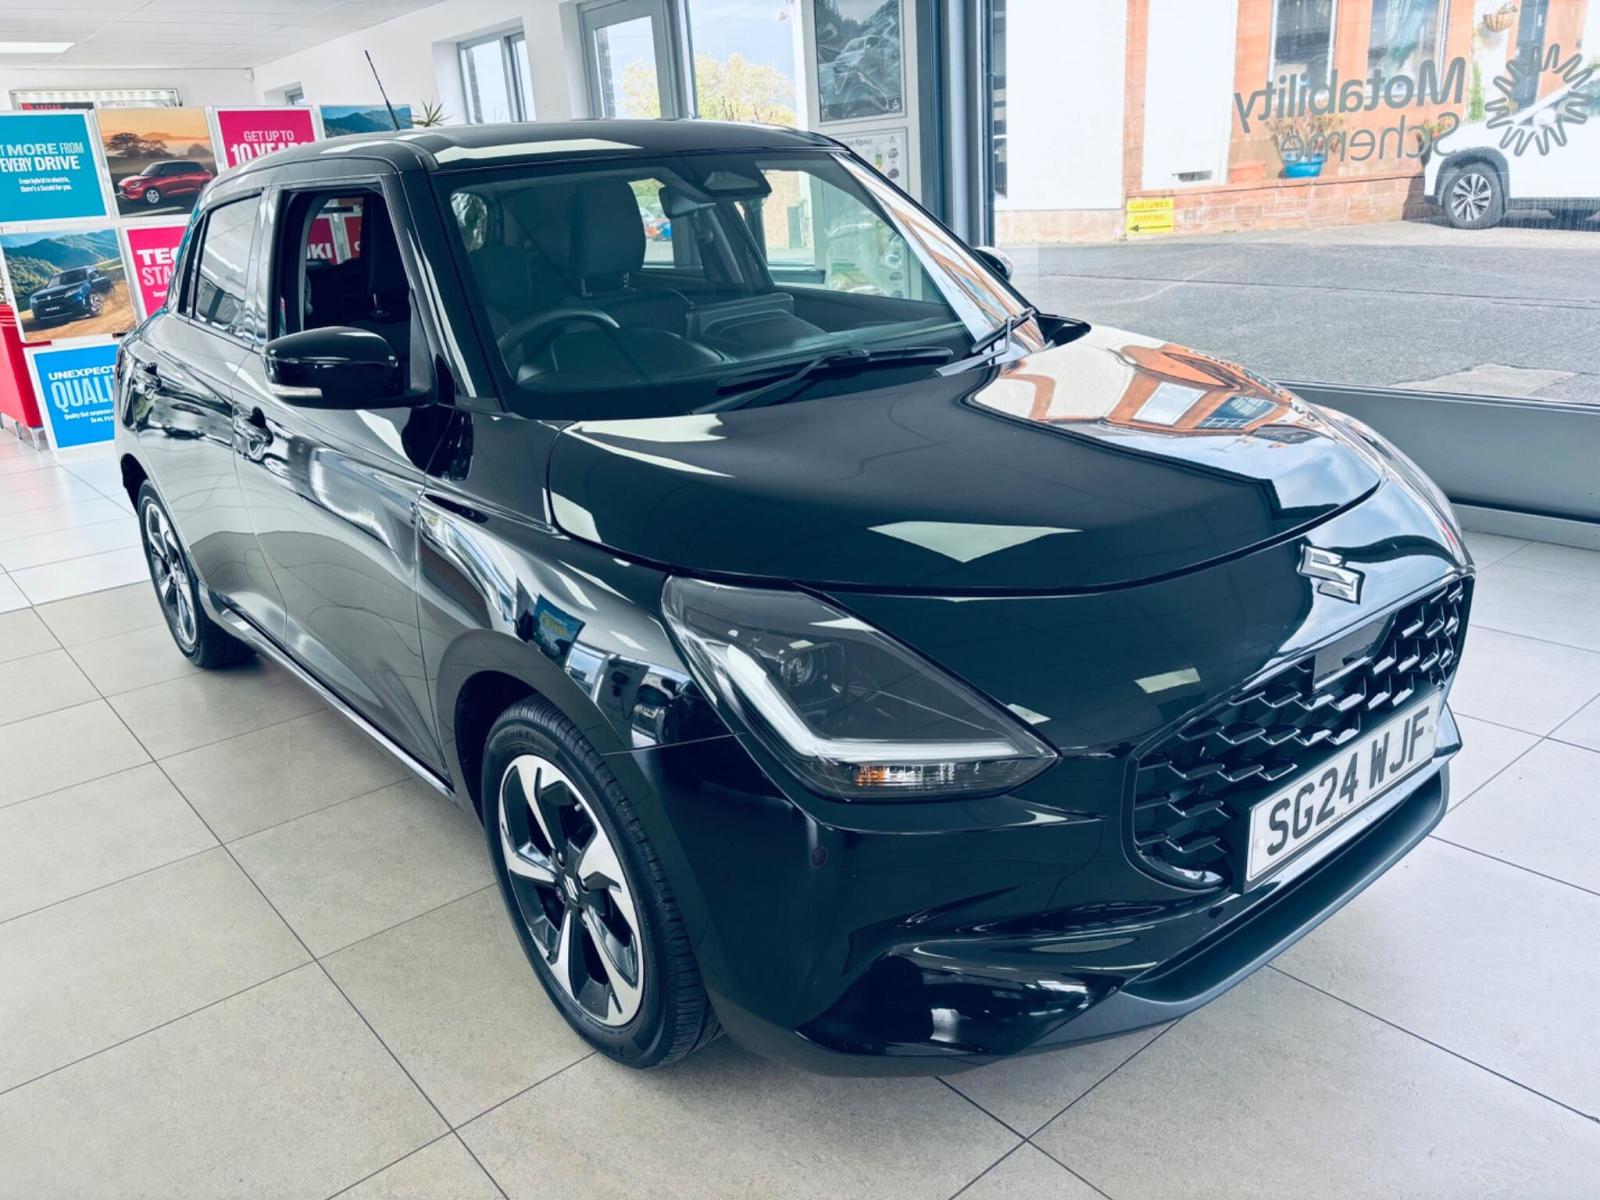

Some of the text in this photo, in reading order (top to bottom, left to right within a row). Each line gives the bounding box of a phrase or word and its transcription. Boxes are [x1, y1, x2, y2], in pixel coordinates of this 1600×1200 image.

[243, 129, 295, 142] GET UP TO
[6, 142, 59, 157] MORE
[59, 141, 85, 155] FROM
[0, 154, 81, 173] EVERY DRIVE
[50, 374, 115, 413] QUALI
[1266, 706, 1430, 856] SG24 WJF
